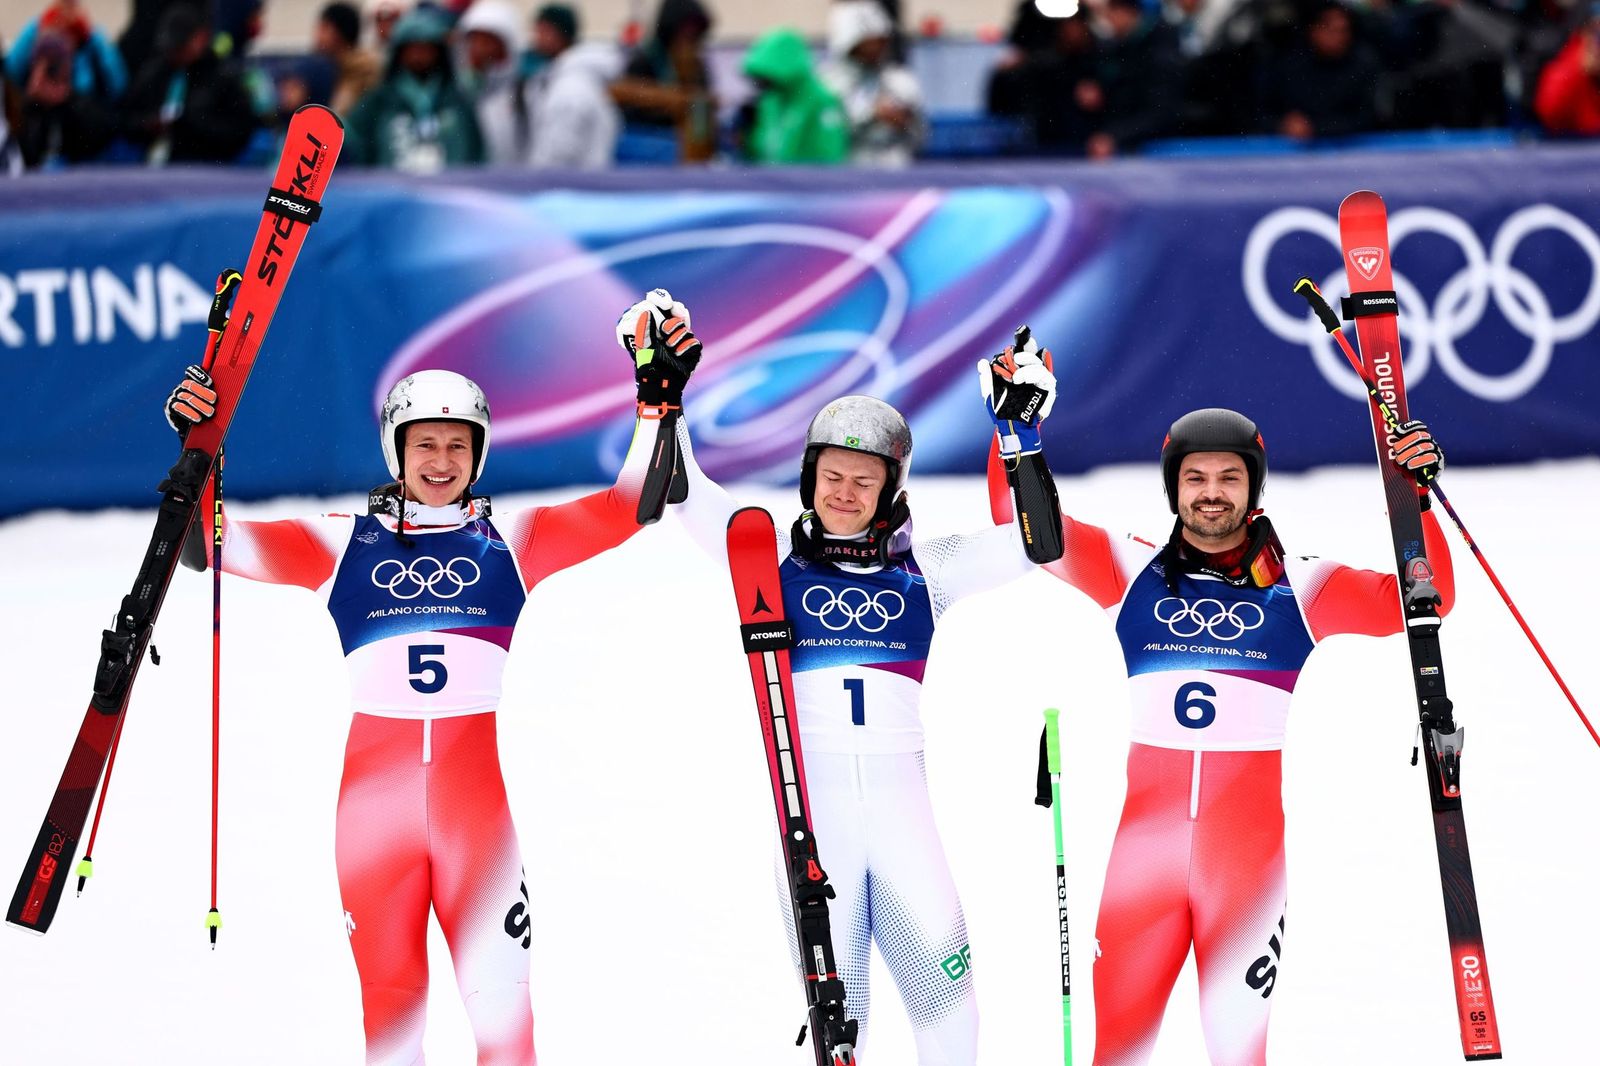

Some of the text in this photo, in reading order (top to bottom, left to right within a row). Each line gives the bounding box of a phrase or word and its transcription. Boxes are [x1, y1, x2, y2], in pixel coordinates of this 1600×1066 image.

[307, 151, 326, 195] SWISS MADE
[268, 195, 311, 213] STÖCKLI
[1020, 391, 1042, 423] racing
[215, 500, 223, 545] LEKI
[824, 546, 878, 557] OAKLEY
[367, 605, 487, 619] MILANO CORTINA 2026
[750, 630, 787, 641] ATOMIC
[797, 638, 907, 650] MILANO CORTINA 2026
[1143, 642, 1268, 660] MILANO CORTINA 2026
[408, 644, 448, 694] 5
[843, 678, 865, 726] 1
[1174, 681, 1217, 730] 6
[39, 854, 58, 879] GS
[1058, 876, 1070, 987] KOMPERDELL
[1461, 955, 1485, 1008] HERO
[1470, 1010, 1487, 1022] GS
